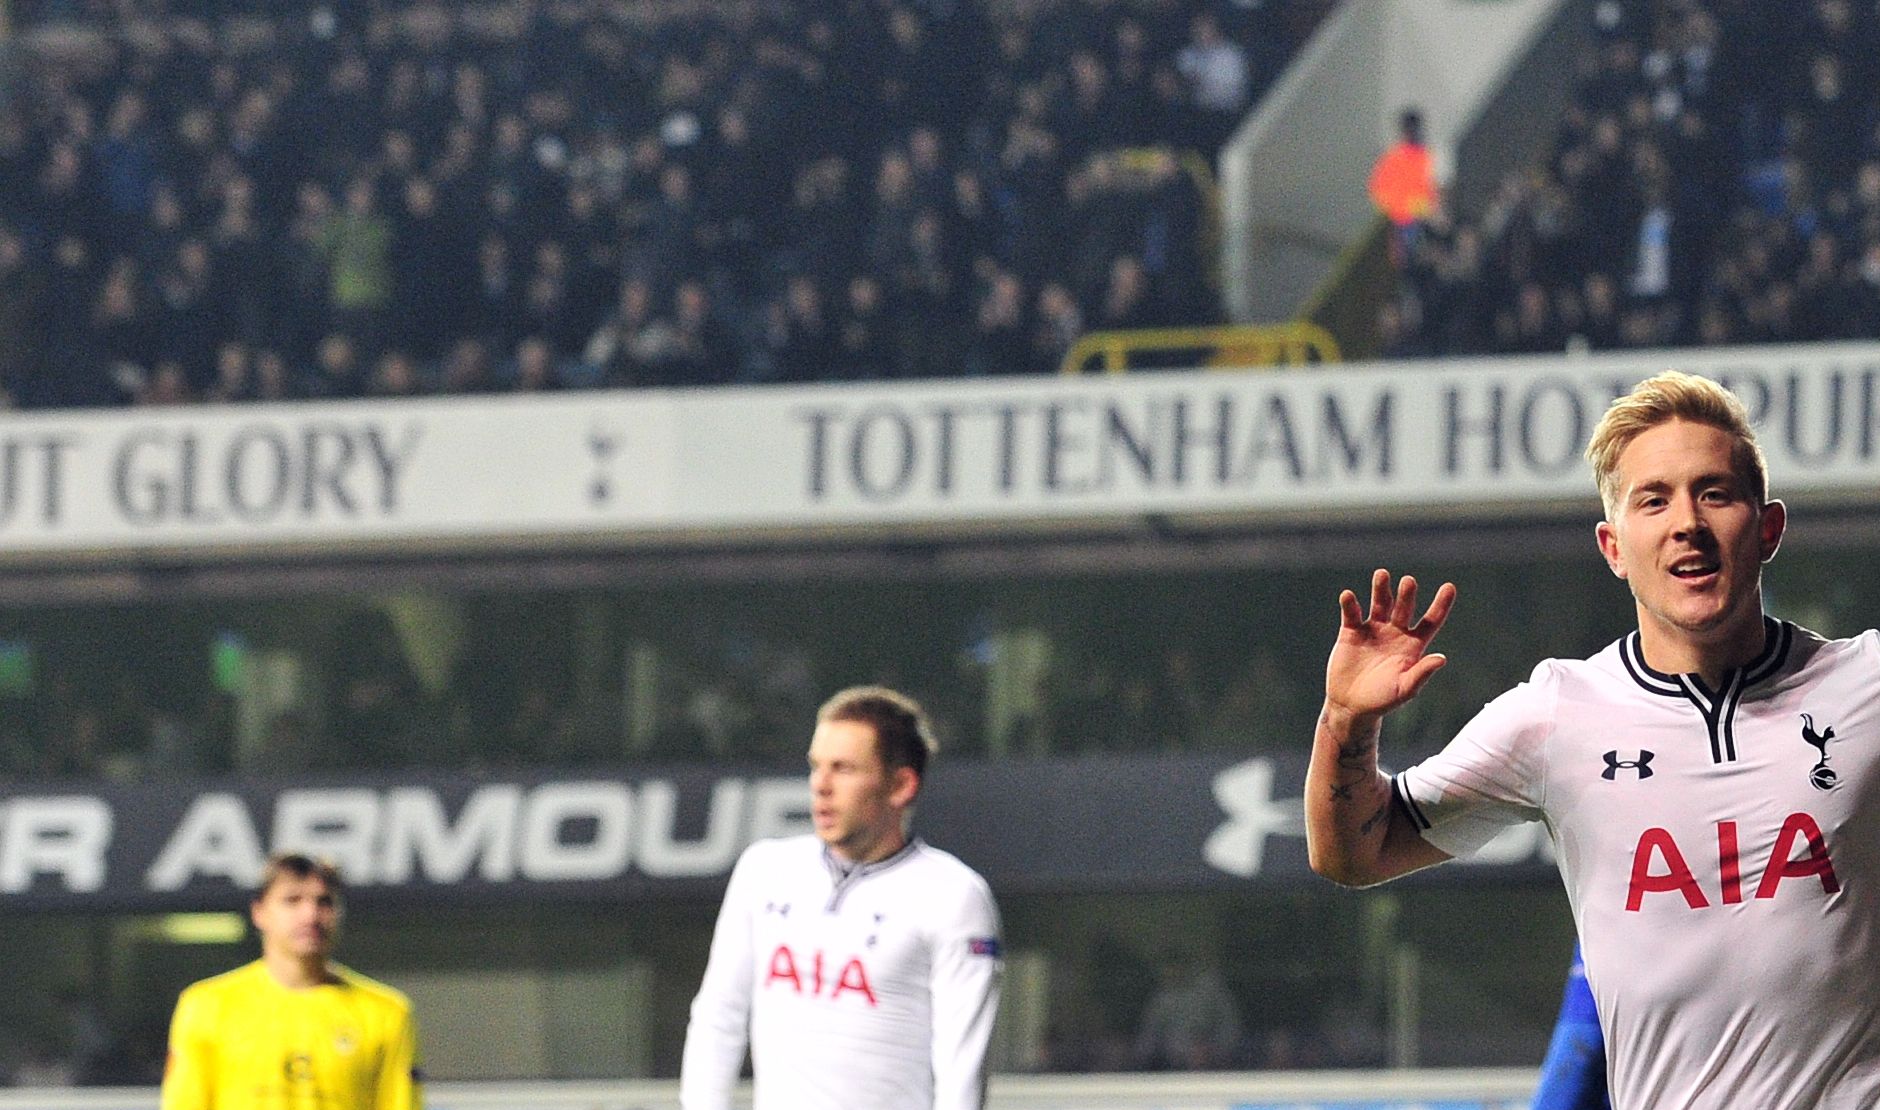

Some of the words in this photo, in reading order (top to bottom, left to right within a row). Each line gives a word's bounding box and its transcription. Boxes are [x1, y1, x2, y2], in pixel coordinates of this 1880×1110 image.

[112, 412, 424, 526] GLORY
[792, 384, 1394, 504] TOTTENHAM
[1625, 812, 1840, 912] AIA
[765, 945, 877, 1008] AIA
